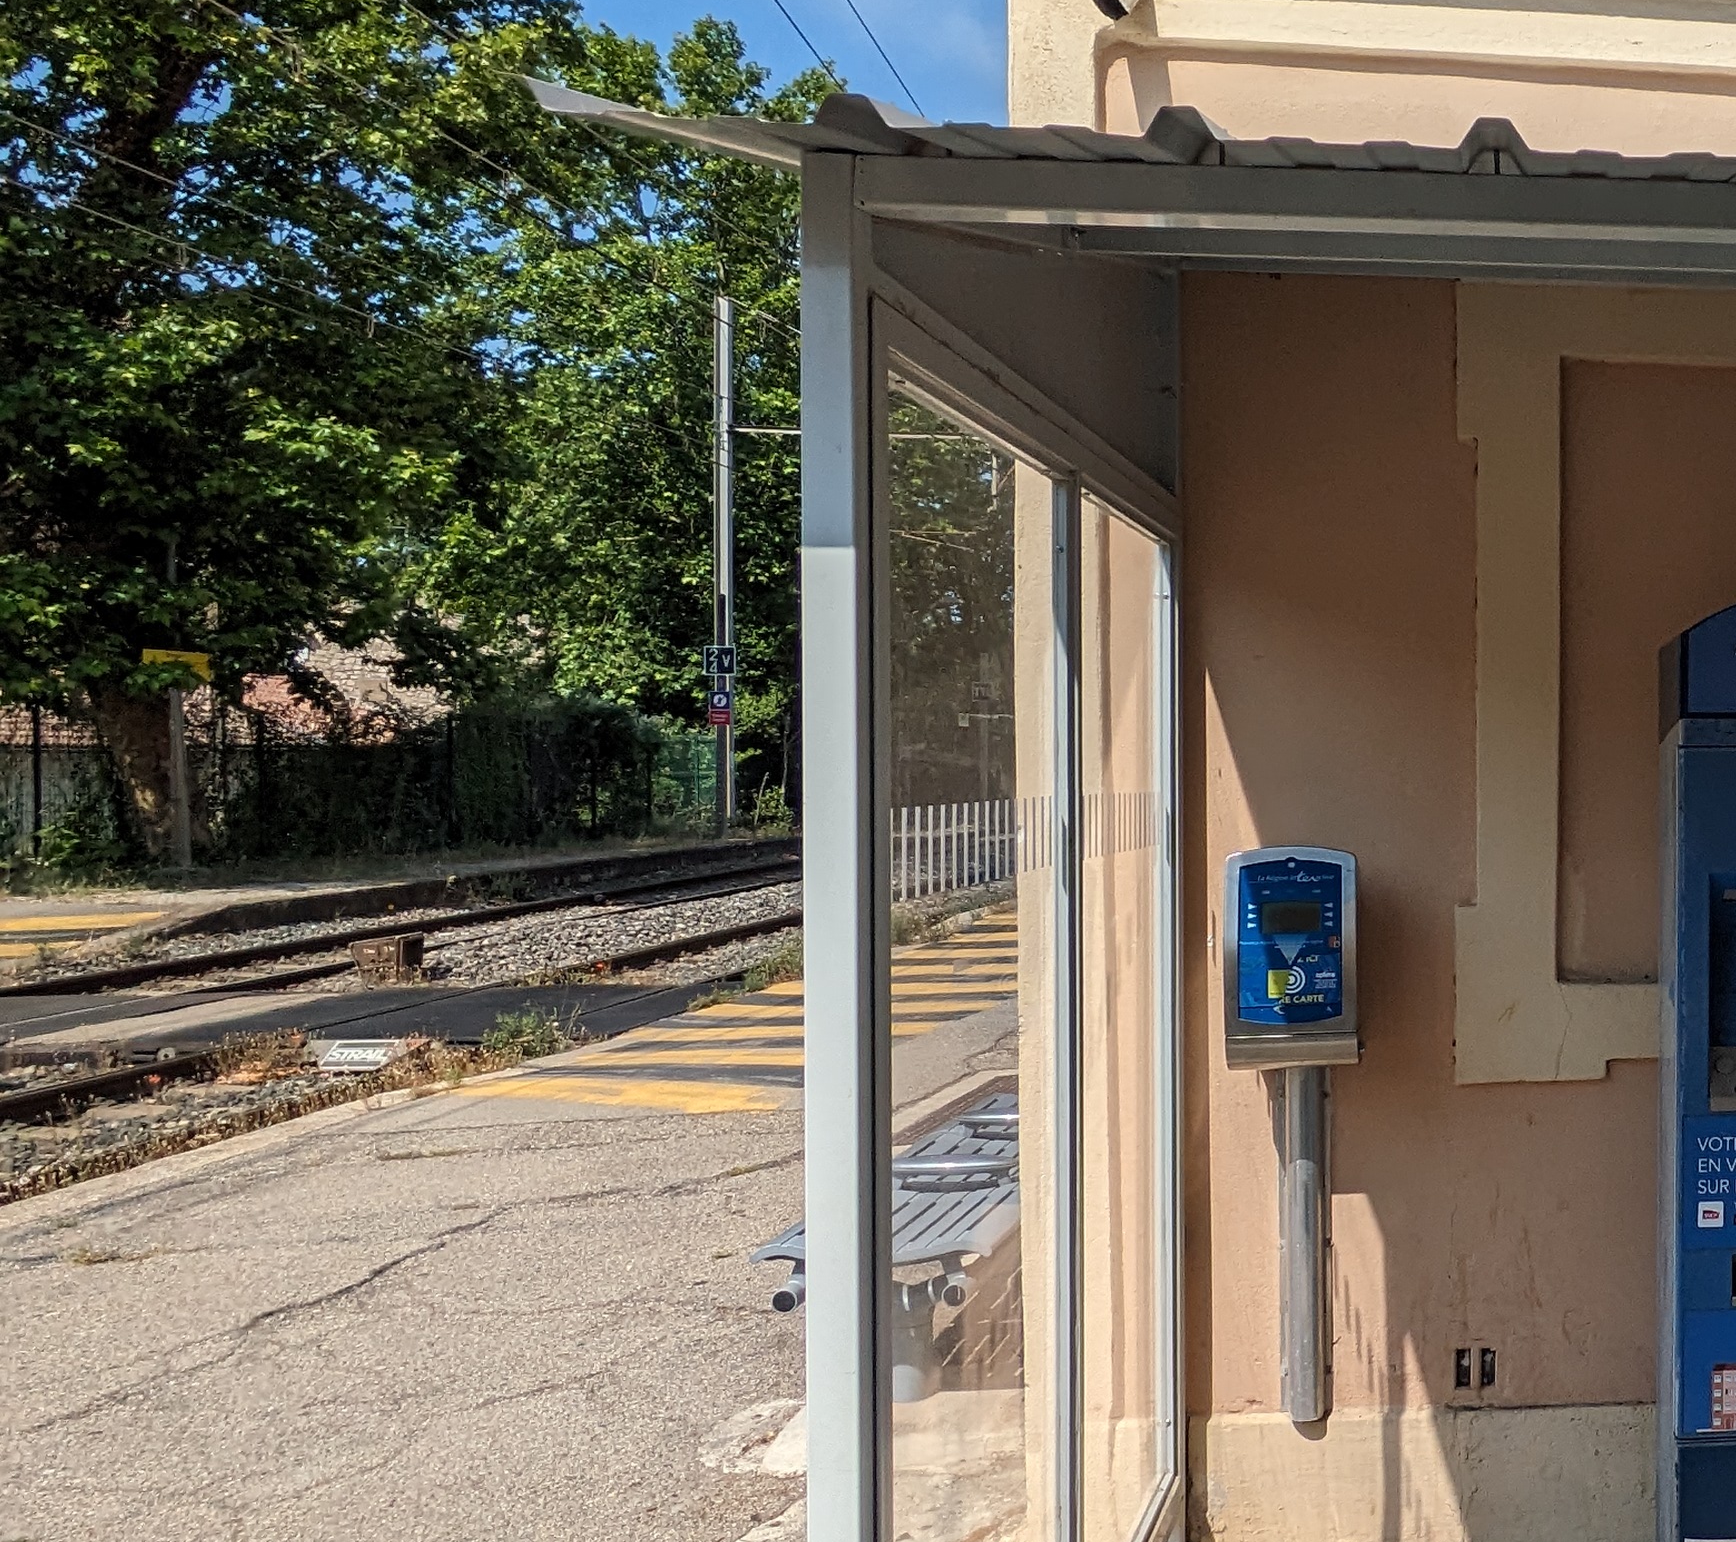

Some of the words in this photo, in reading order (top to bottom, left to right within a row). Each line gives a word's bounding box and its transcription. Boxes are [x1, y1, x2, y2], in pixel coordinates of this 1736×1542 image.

[1293, 994, 1325, 1003] CARTE
[1698, 1158, 1721, 1173] EN
[1698, 1179, 1730, 1194] SUR
